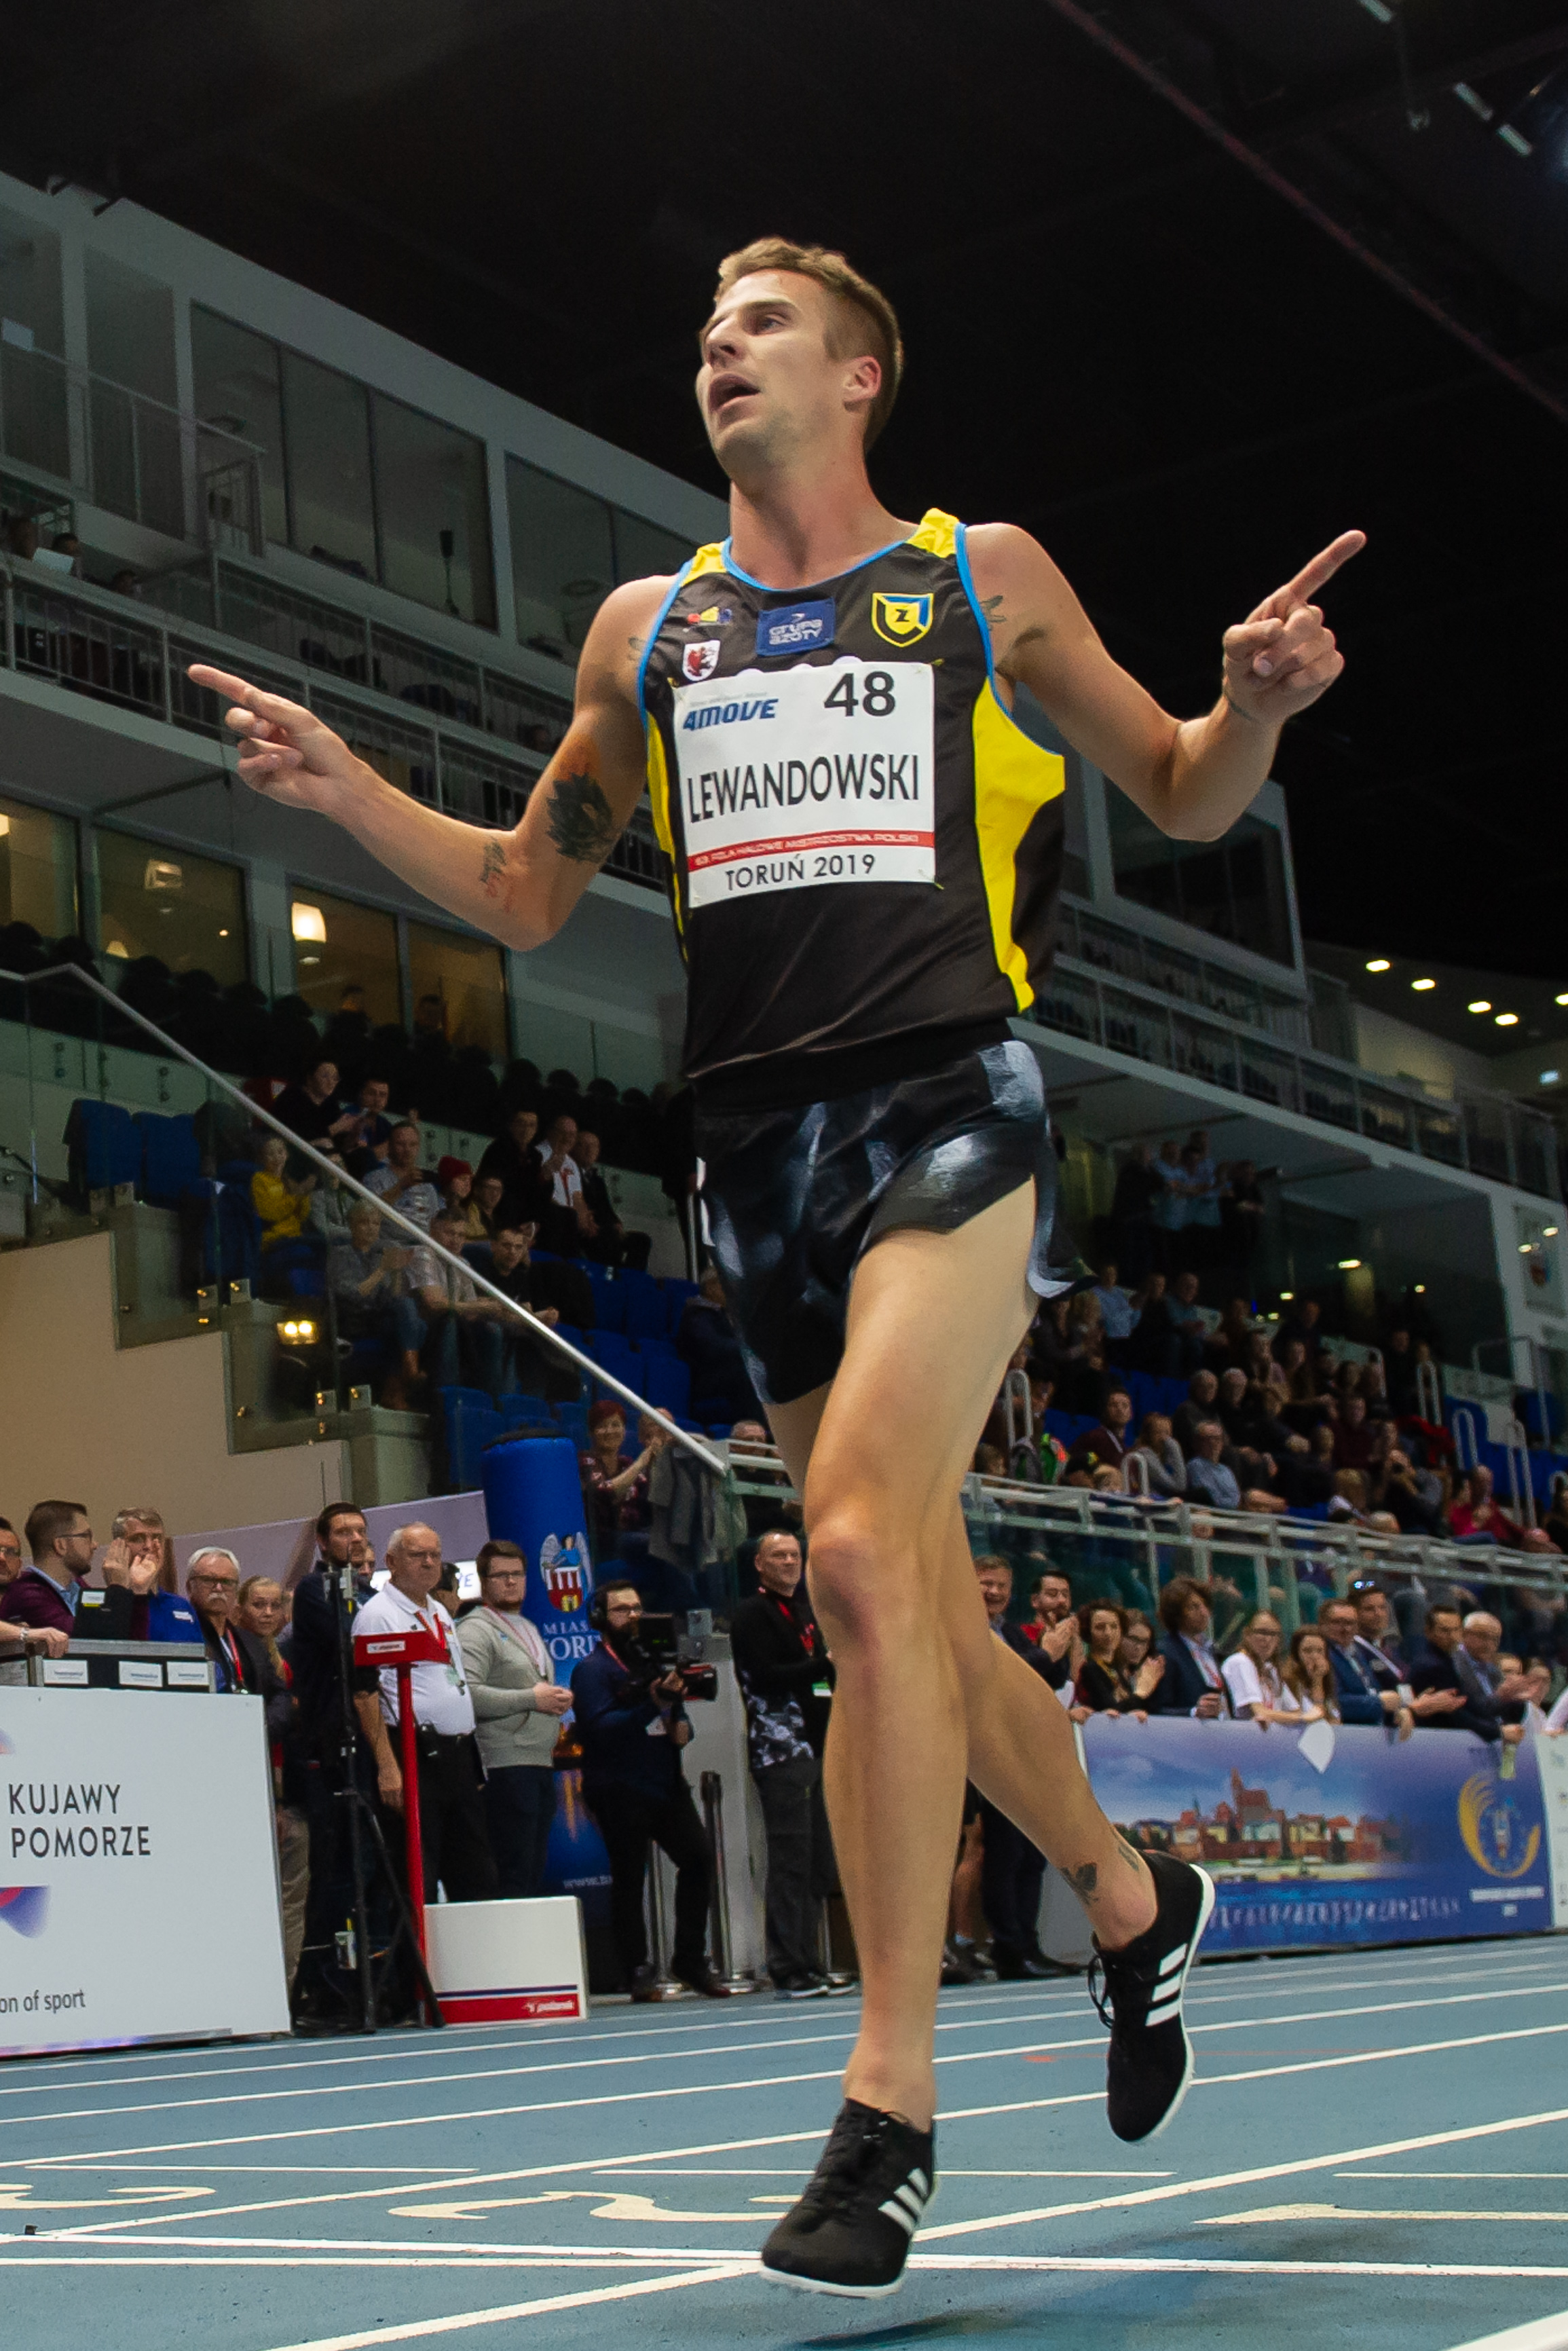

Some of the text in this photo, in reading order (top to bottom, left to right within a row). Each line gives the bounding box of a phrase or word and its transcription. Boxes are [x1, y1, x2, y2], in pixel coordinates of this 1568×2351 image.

[895, 608, 910, 623] Z
[824, 671, 896, 717] 48
[683, 699, 779, 731] 4MOVE
[687, 754, 919, 823] LEWANDOWSKI
[726, 853, 876, 891] TORUŃ 2019
[9, 1783, 121, 1815] KUJAWY
[11, 1826, 151, 1858] POMORZE
[23, 1989, 39, 2011] of
[44, 1988, 86, 2014] sport
